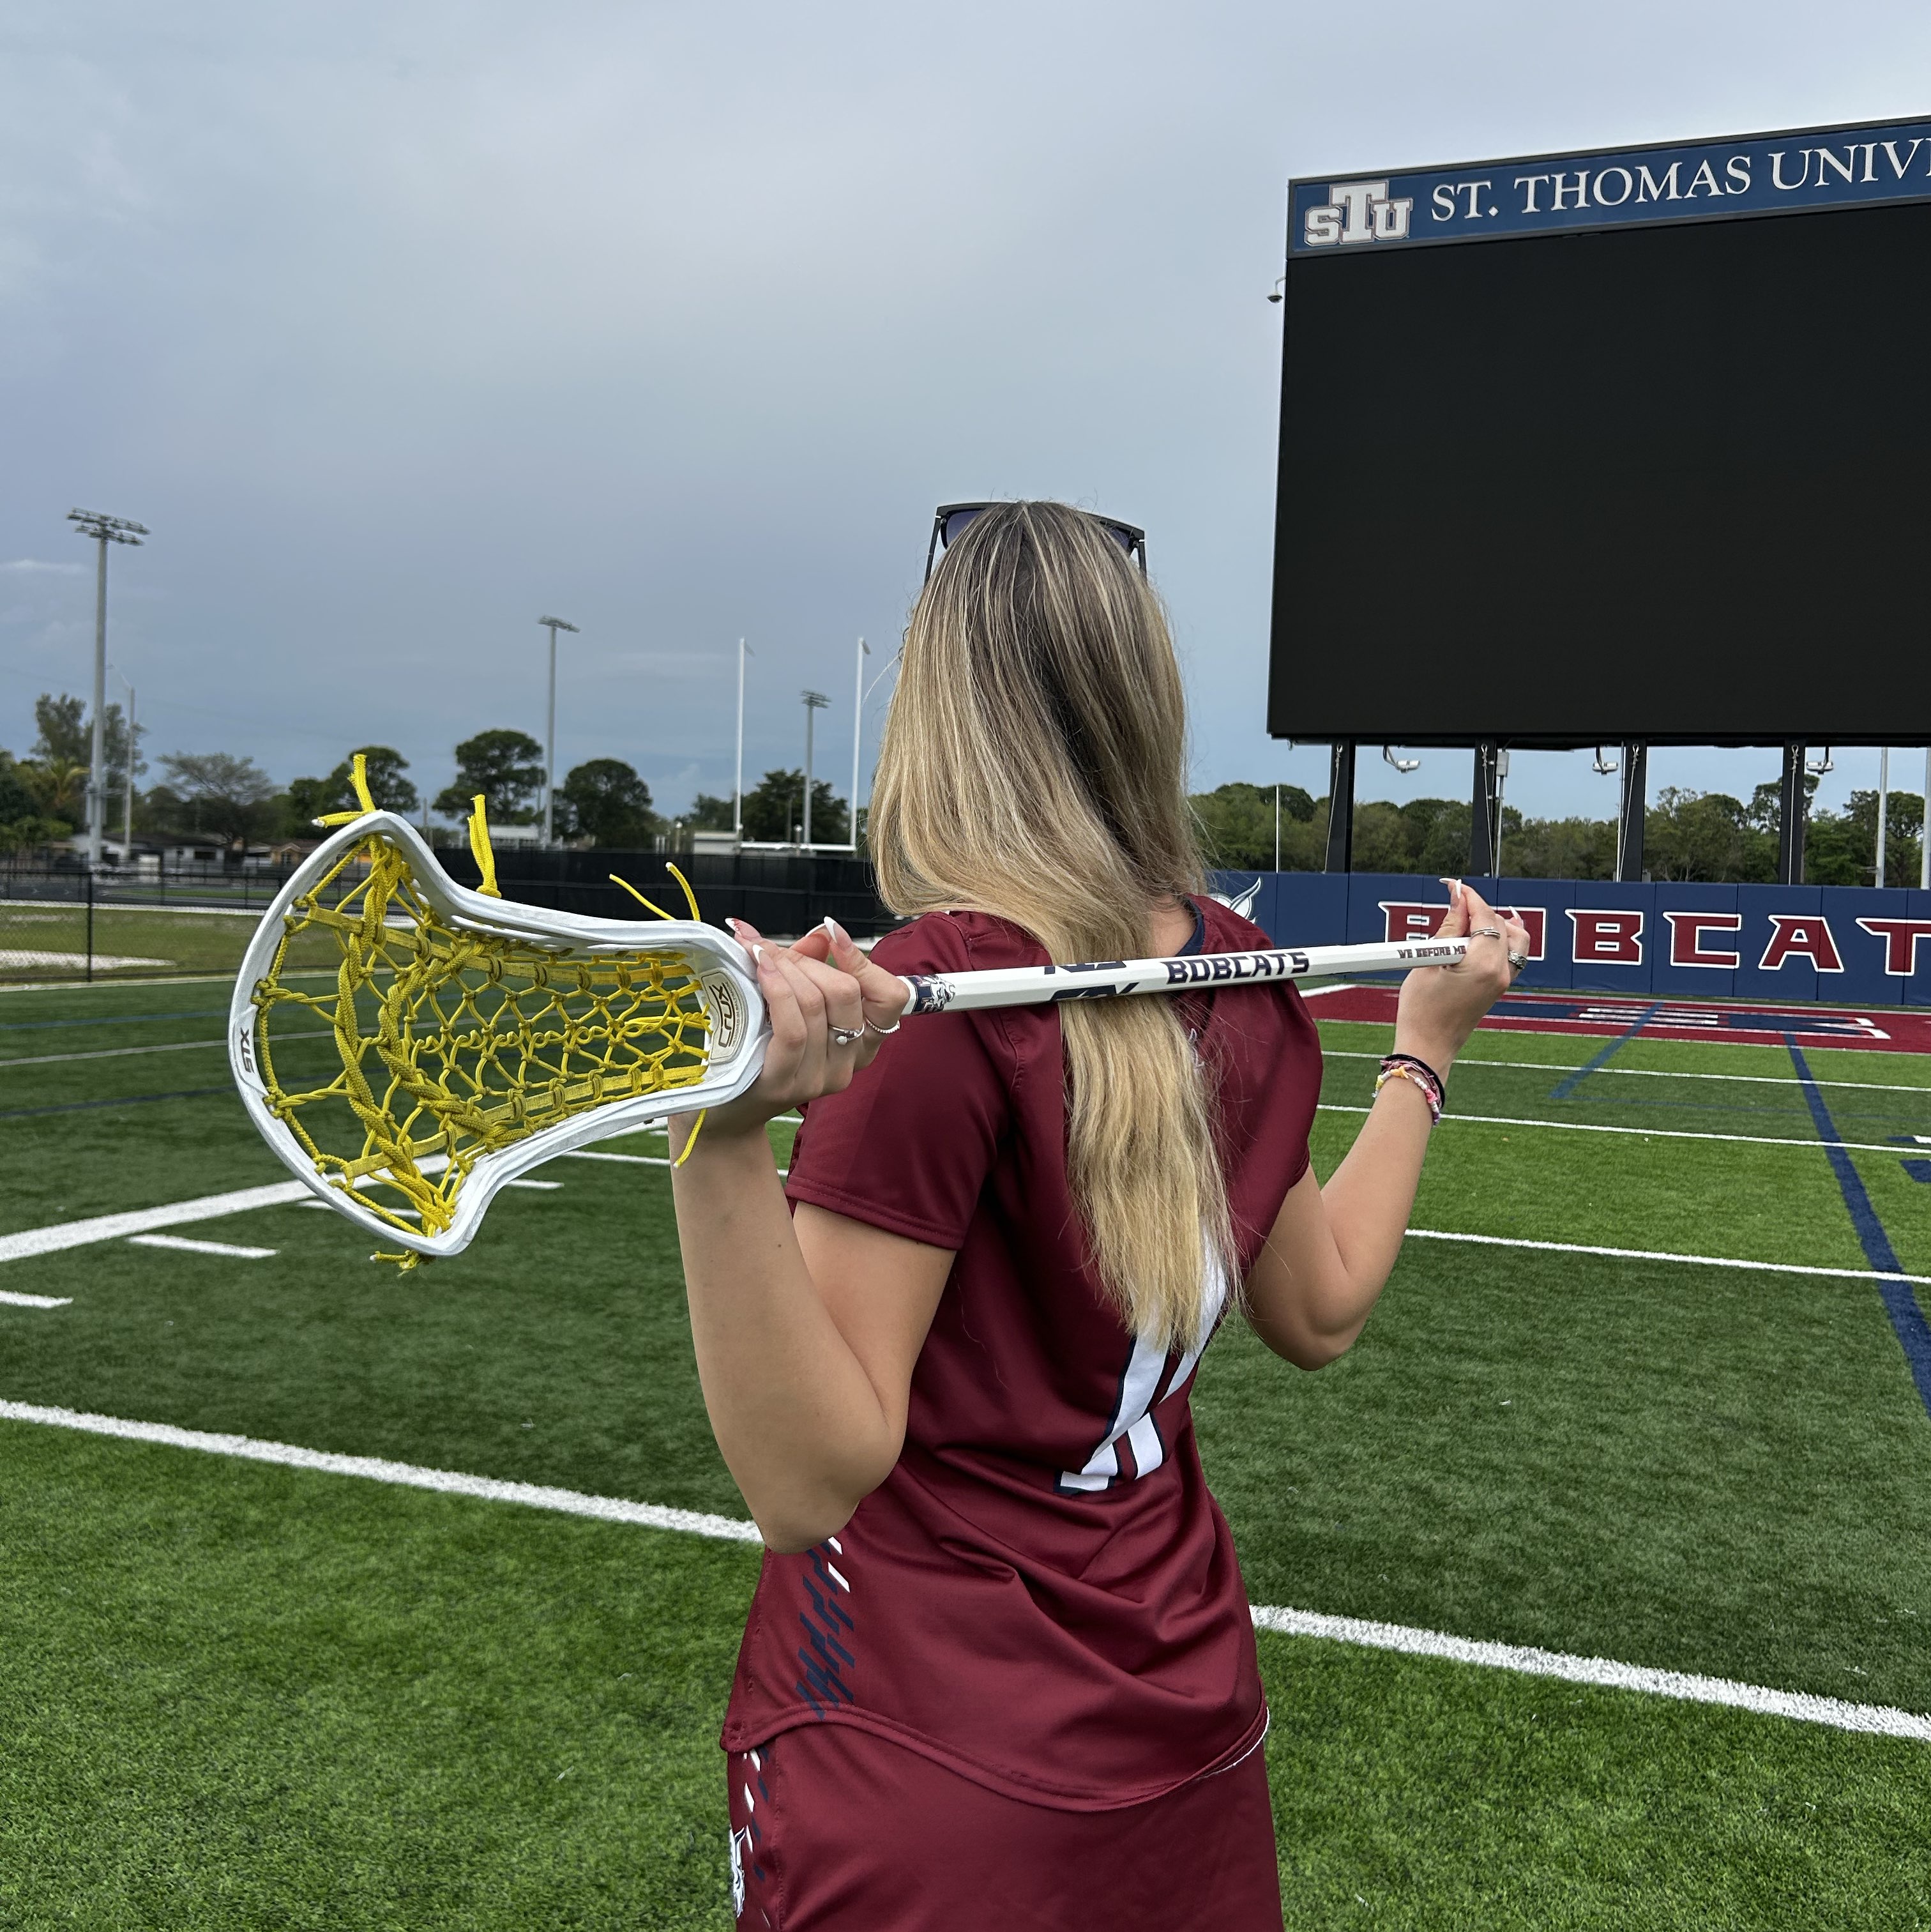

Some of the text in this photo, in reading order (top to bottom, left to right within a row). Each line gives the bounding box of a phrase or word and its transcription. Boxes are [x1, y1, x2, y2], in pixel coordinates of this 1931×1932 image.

[1431, 137, 1931, 222] ST. THOMAS UNIV
[1304, 179, 1413, 247] STU
[1160, 951, 1309, 984] BOBCATS
[1397, 945, 1466, 959] WE BEFORE ME
[240, 1027, 255, 1074] STX
